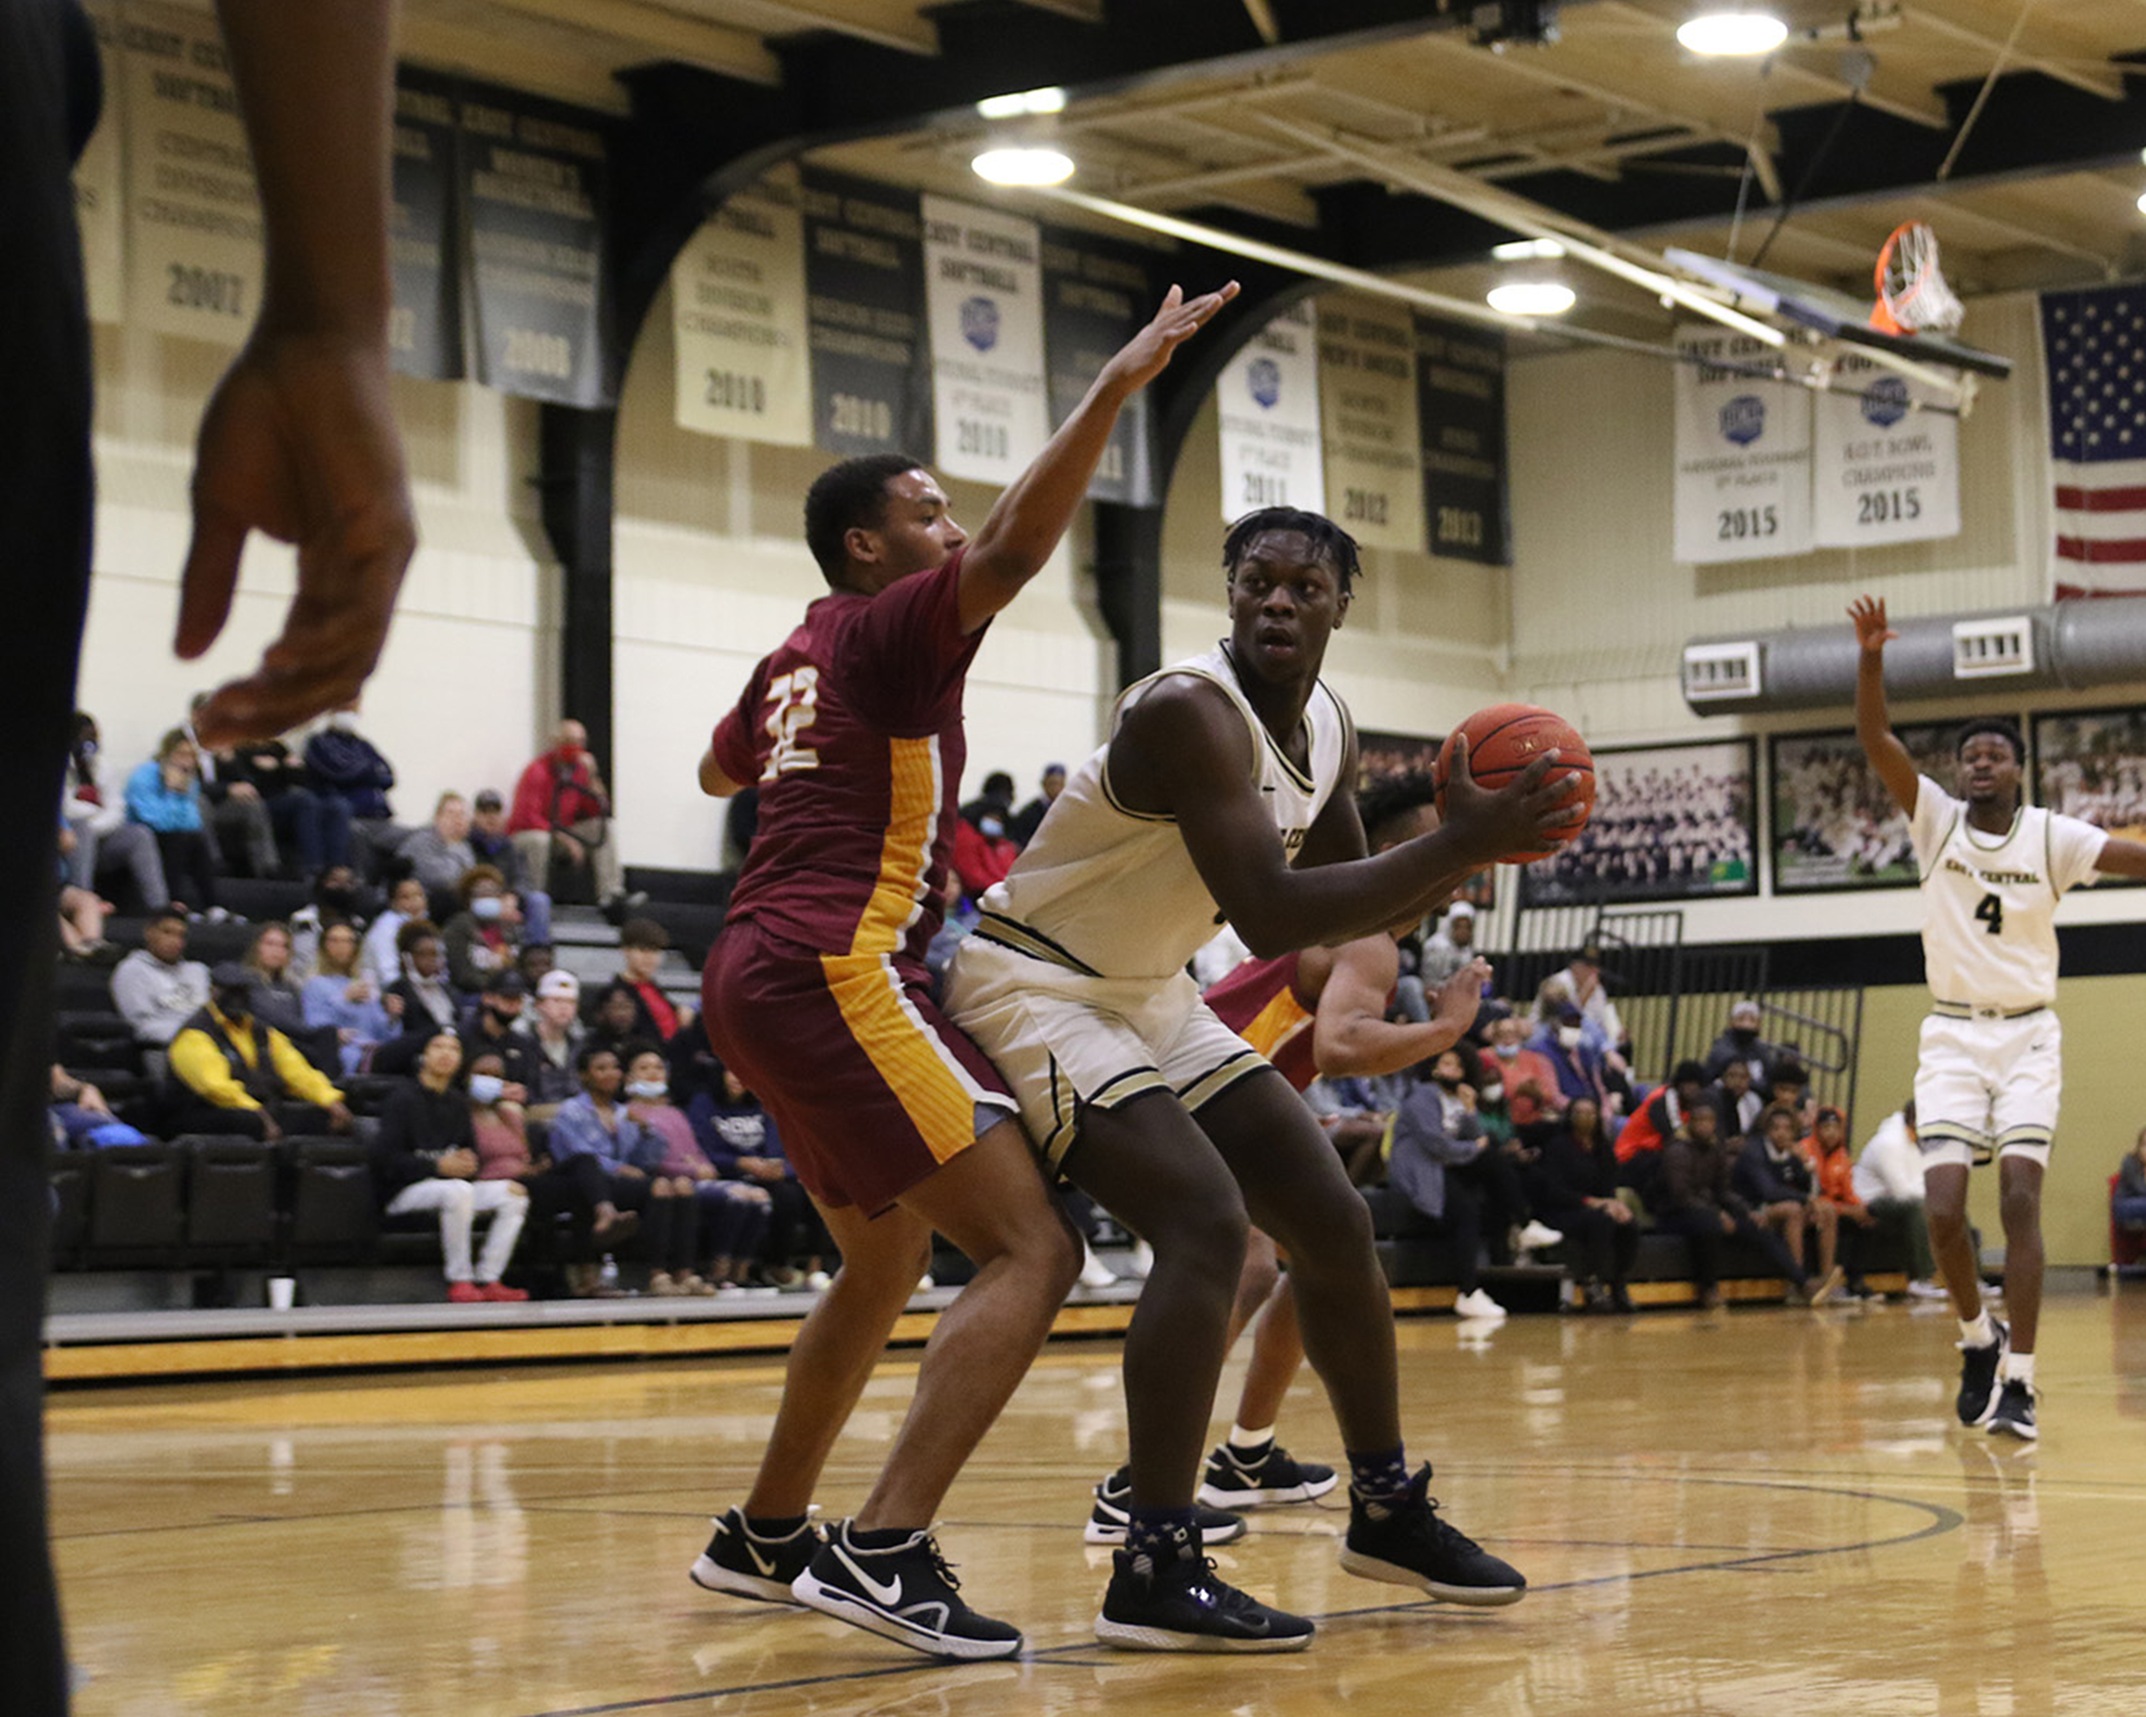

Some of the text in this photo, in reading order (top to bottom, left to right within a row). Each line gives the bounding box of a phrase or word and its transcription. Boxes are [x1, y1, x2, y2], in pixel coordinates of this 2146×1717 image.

[1718, 504, 1778, 539] 2015
[1857, 487, 1921, 524] 2015
[1974, 892, 2003, 935] 4
